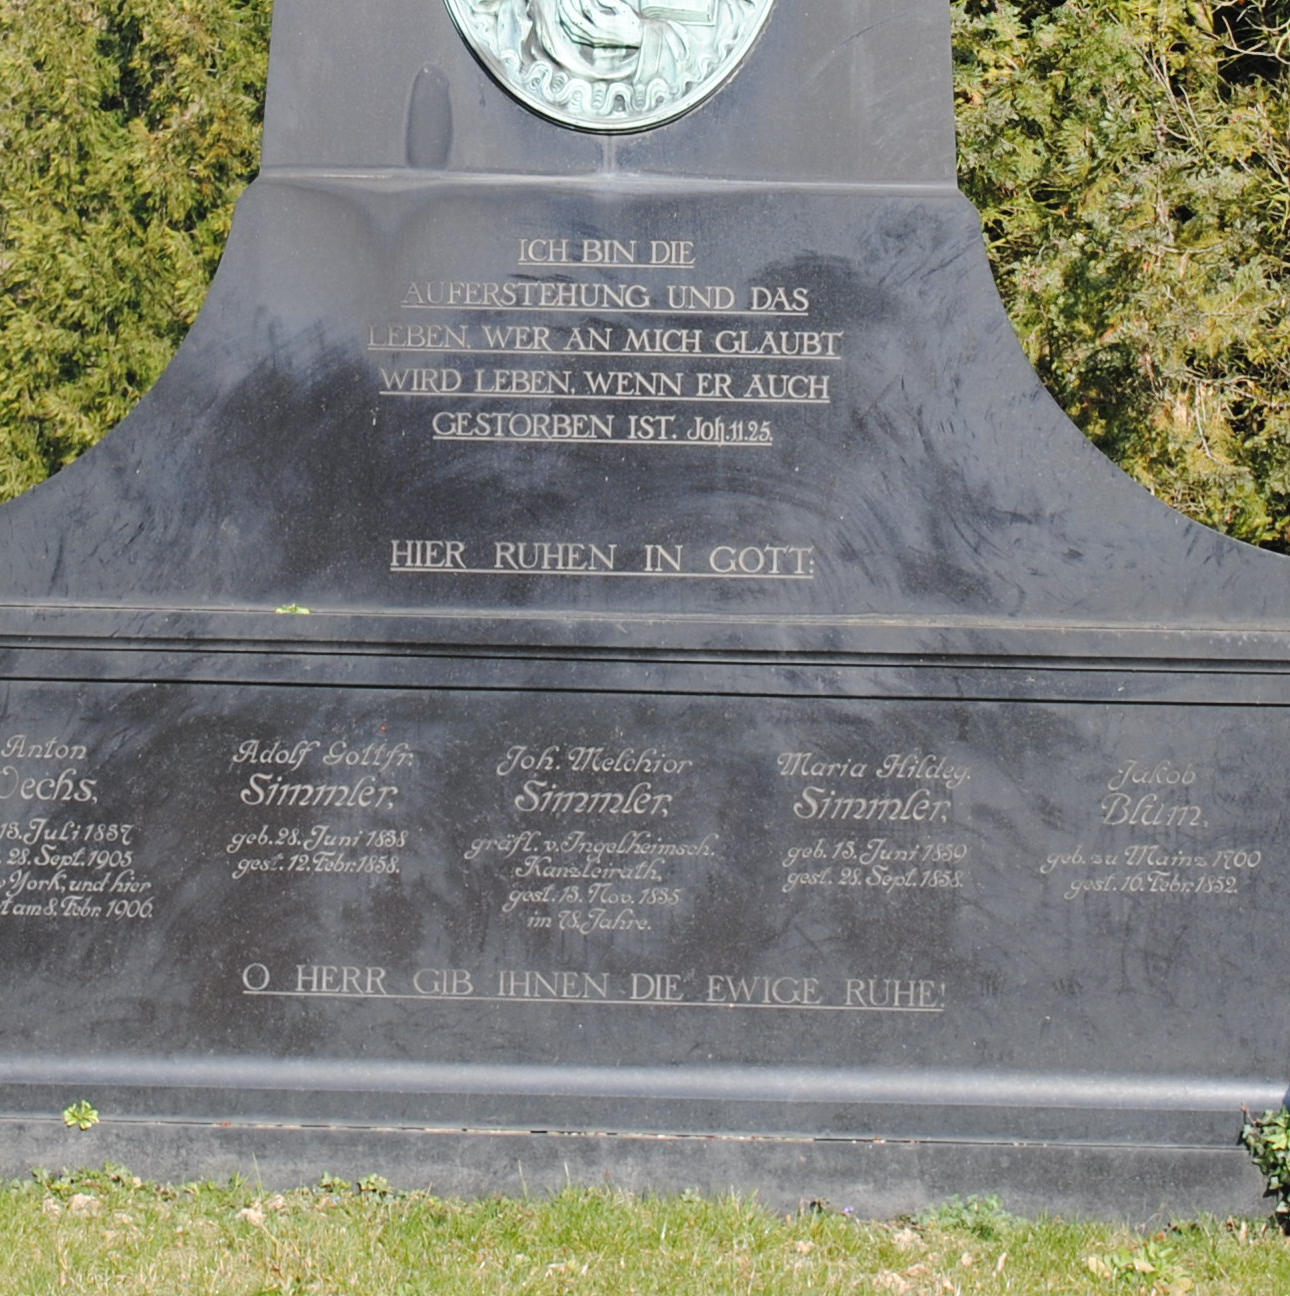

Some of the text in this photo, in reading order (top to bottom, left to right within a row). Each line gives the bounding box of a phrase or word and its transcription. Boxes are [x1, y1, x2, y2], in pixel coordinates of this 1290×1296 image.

[518, 238, 696, 265] ICH BIN DIE
[401, 280, 809, 312] AUFERSTEHUNG UND DAS
[482, 324, 554, 352] WER
[563, 326, 612, 351] AN
[622, 328, 703, 353] MICH
[715, 330, 845, 355] GLAUBT
[379, 367, 831, 399] WIRD LEBEN, WENN ER AUCH
[431, 411, 615, 440] GESTORBEN
[627, 414, 677, 440] IST.
[390, 539, 815, 574] HIER RUHEN IN GOTT:
[1, 734, 87, 760] Anton
[232, 739, 321, 772] Adolf
[496, 745, 693, 776] Joh. Melchior
[776, 752, 972, 789] Maria Hildeg.
[1107, 759, 1197, 791] Jakob
[240, 772, 399, 810] Simmler,
[514, 779, 673, 818] Simmler,
[792, 785, 952, 823] Simmler,
[1100, 792, 1209, 828] Blum,
[23, 817, 82, 845] Juli
[226, 824, 273, 854] geb.
[274, 826, 302, 846] 28.
[303, 824, 364, 851] Juni
[463, 830, 542, 860] gräfl.
[543, 837, 560, 853] v.
[6, 847, 31, 867] 28.
[34, 843, 86, 870] Sept.
[86, 849, 133, 870] 1905
[287, 854, 311, 872] 12.
[356, 855, 401, 874] 1858.
[782, 837, 828, 868] geb.
[859, 838, 921, 865] Juni
[1039, 844, 1086, 874] geb.
[1090, 853, 1119, 866] zu
[1124, 844, 1208, 867] Mainz
[6, 869, 67, 898] York,
[68, 871, 111, 892] und
[109, 869, 152, 893] hier
[782, 864, 965, 894] gest. 28. Sept. 1858.
[1063, 873, 1117, 900] gest.
[1147, 869, 1193, 892] Febr.
[1194, 874, 1239, 894] 1852.
[13, 903, 41, 916] am
[43, 897, 58, 917] 8.
[60, 894, 102, 917] Febr.
[105, 896, 156, 921] 1906.
[501, 882, 557, 913] gest.
[588, 882, 635, 904] Nov.
[526, 910, 552, 928] im
[580, 907, 652, 935] Jahre.
[242, 962, 946, 1008] O HERR GIB IHNEN DIE EWIGE RUHE!
